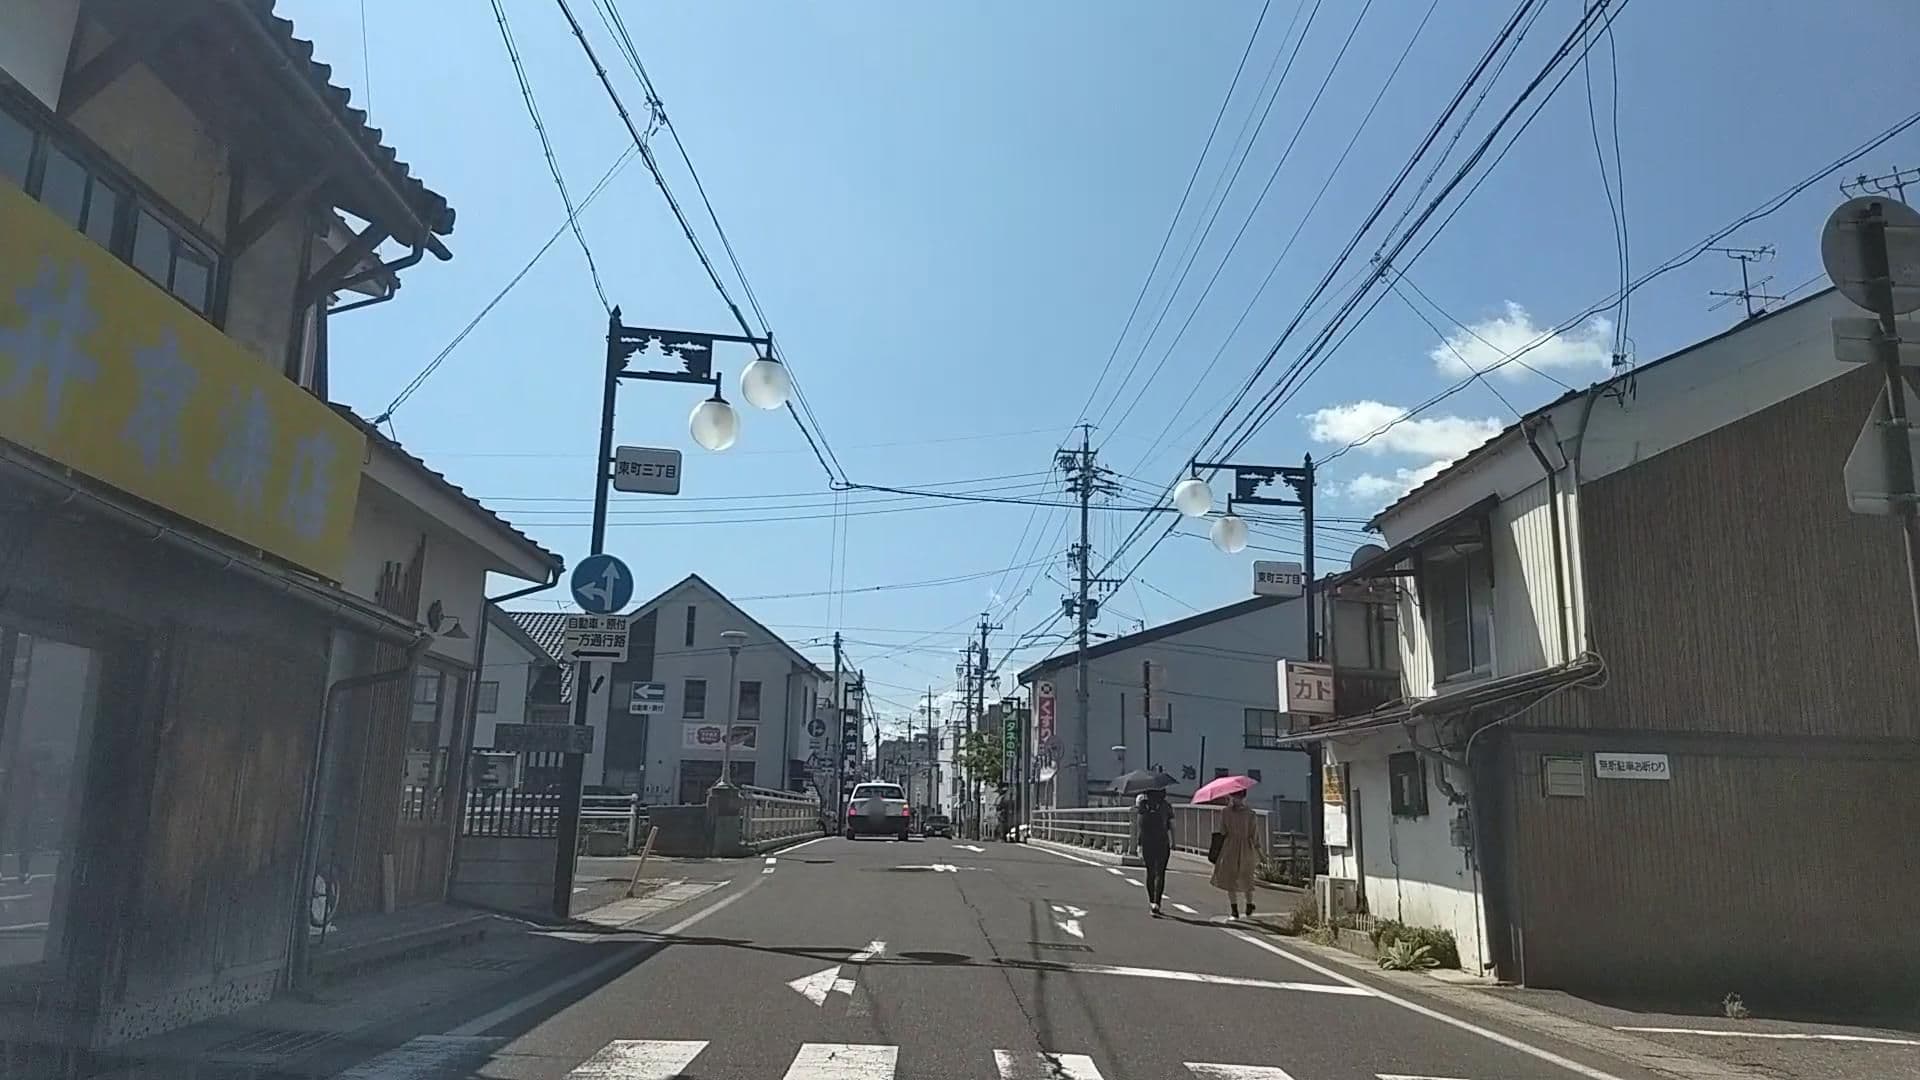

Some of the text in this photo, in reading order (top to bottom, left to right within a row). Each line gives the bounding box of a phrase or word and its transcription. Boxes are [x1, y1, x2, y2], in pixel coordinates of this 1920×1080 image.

[617, 460, 677, 479] 東町三丁目
[1257, 571, 1300, 585] 東町三丁目
[567, 633, 627, 648] 一方通行路
[1599, 759, 1667, 773] 無断駐車お断わり
